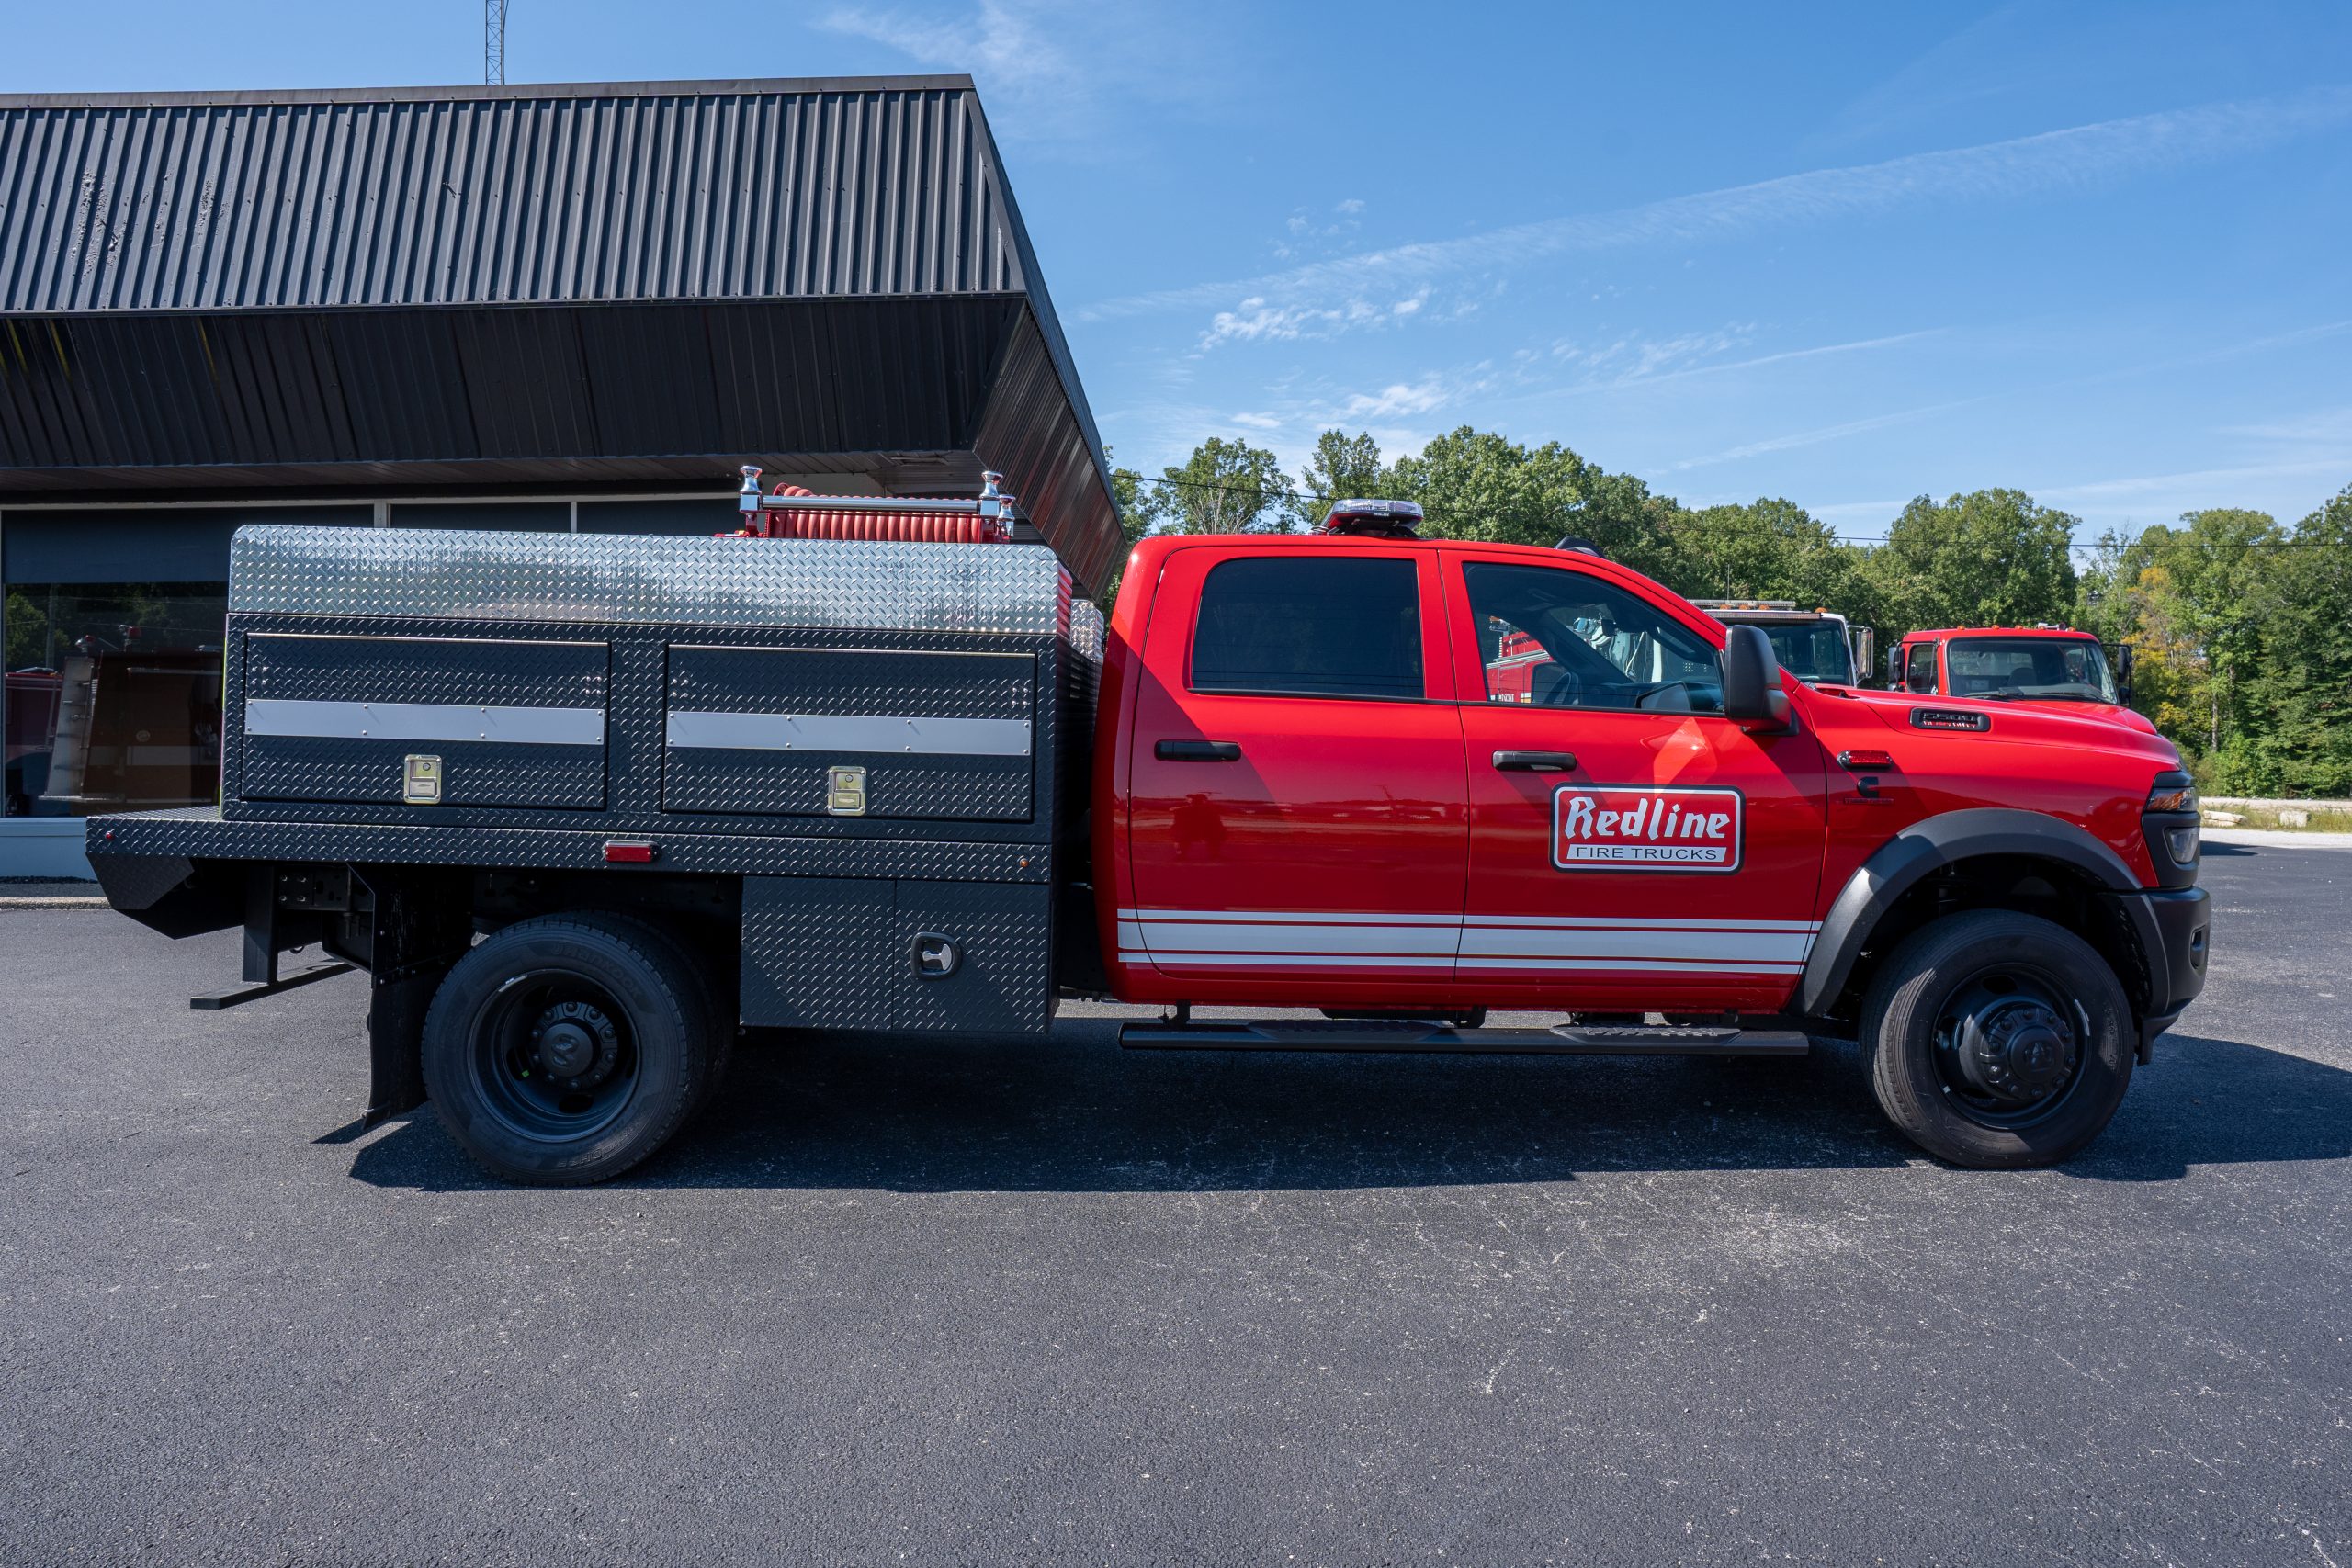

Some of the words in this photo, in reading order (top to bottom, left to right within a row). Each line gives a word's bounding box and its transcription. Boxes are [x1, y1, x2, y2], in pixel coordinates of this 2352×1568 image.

[1565, 796, 1730, 840] Redline
[1577, 847, 1623, 859] FIRE
[1631, 848, 1717, 861] TRUCKS
